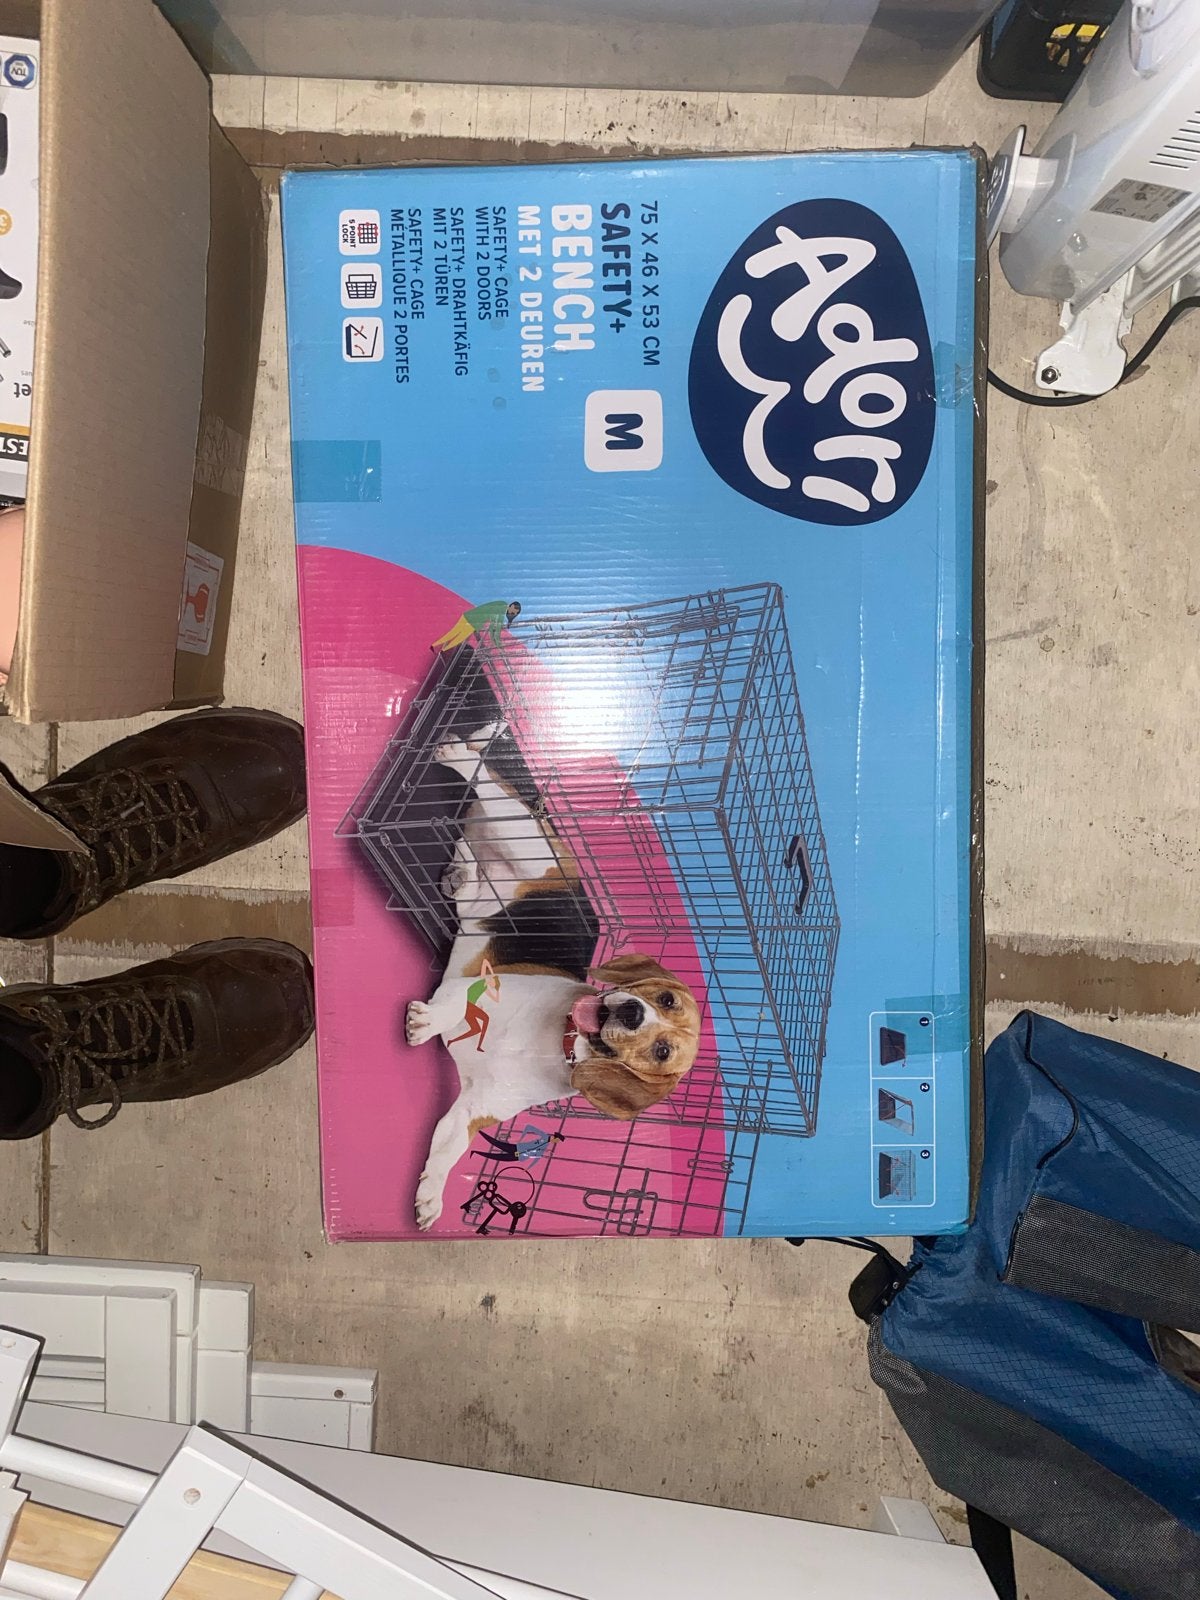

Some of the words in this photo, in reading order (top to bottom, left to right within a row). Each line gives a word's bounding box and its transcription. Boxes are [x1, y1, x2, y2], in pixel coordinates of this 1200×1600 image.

[433, 208, 446, 235] MIT
[476, 207, 489, 245] WITH
[518, 206, 541, 256] MET
[641, 201, 658, 224] 75
[391, 209, 410, 304] MÉTALLIQUE
[408, 209, 423, 273] SAFETY+
[434, 241, 447, 249] 2
[450, 208, 465, 272] SAFETY+
[477, 252, 489, 260] 2
[493, 206, 507, 271] SAFETY+
[642, 233, 658, 245] X
[435, 254, 451, 305] TÜREN
[520, 267, 542, 281] 2
[551, 205, 595, 350] BENCH
[601, 203, 632, 333] SAFETY+
[642, 252, 659, 277] 46
[410, 279, 424, 319] CAGE
[477, 267, 491, 320] DOORS
[495, 277, 508, 317] CAGE
[642, 285, 659, 297] X
[394, 310, 407, 319] 2
[453, 279, 470, 376] DRAHTKÄFIG
[643, 305, 659, 328] 53
[395, 325, 409, 383] PORTES
[520, 293, 544, 391] DEUREN
[643, 336, 660, 365] CM
[605, 414, 643, 450] M
